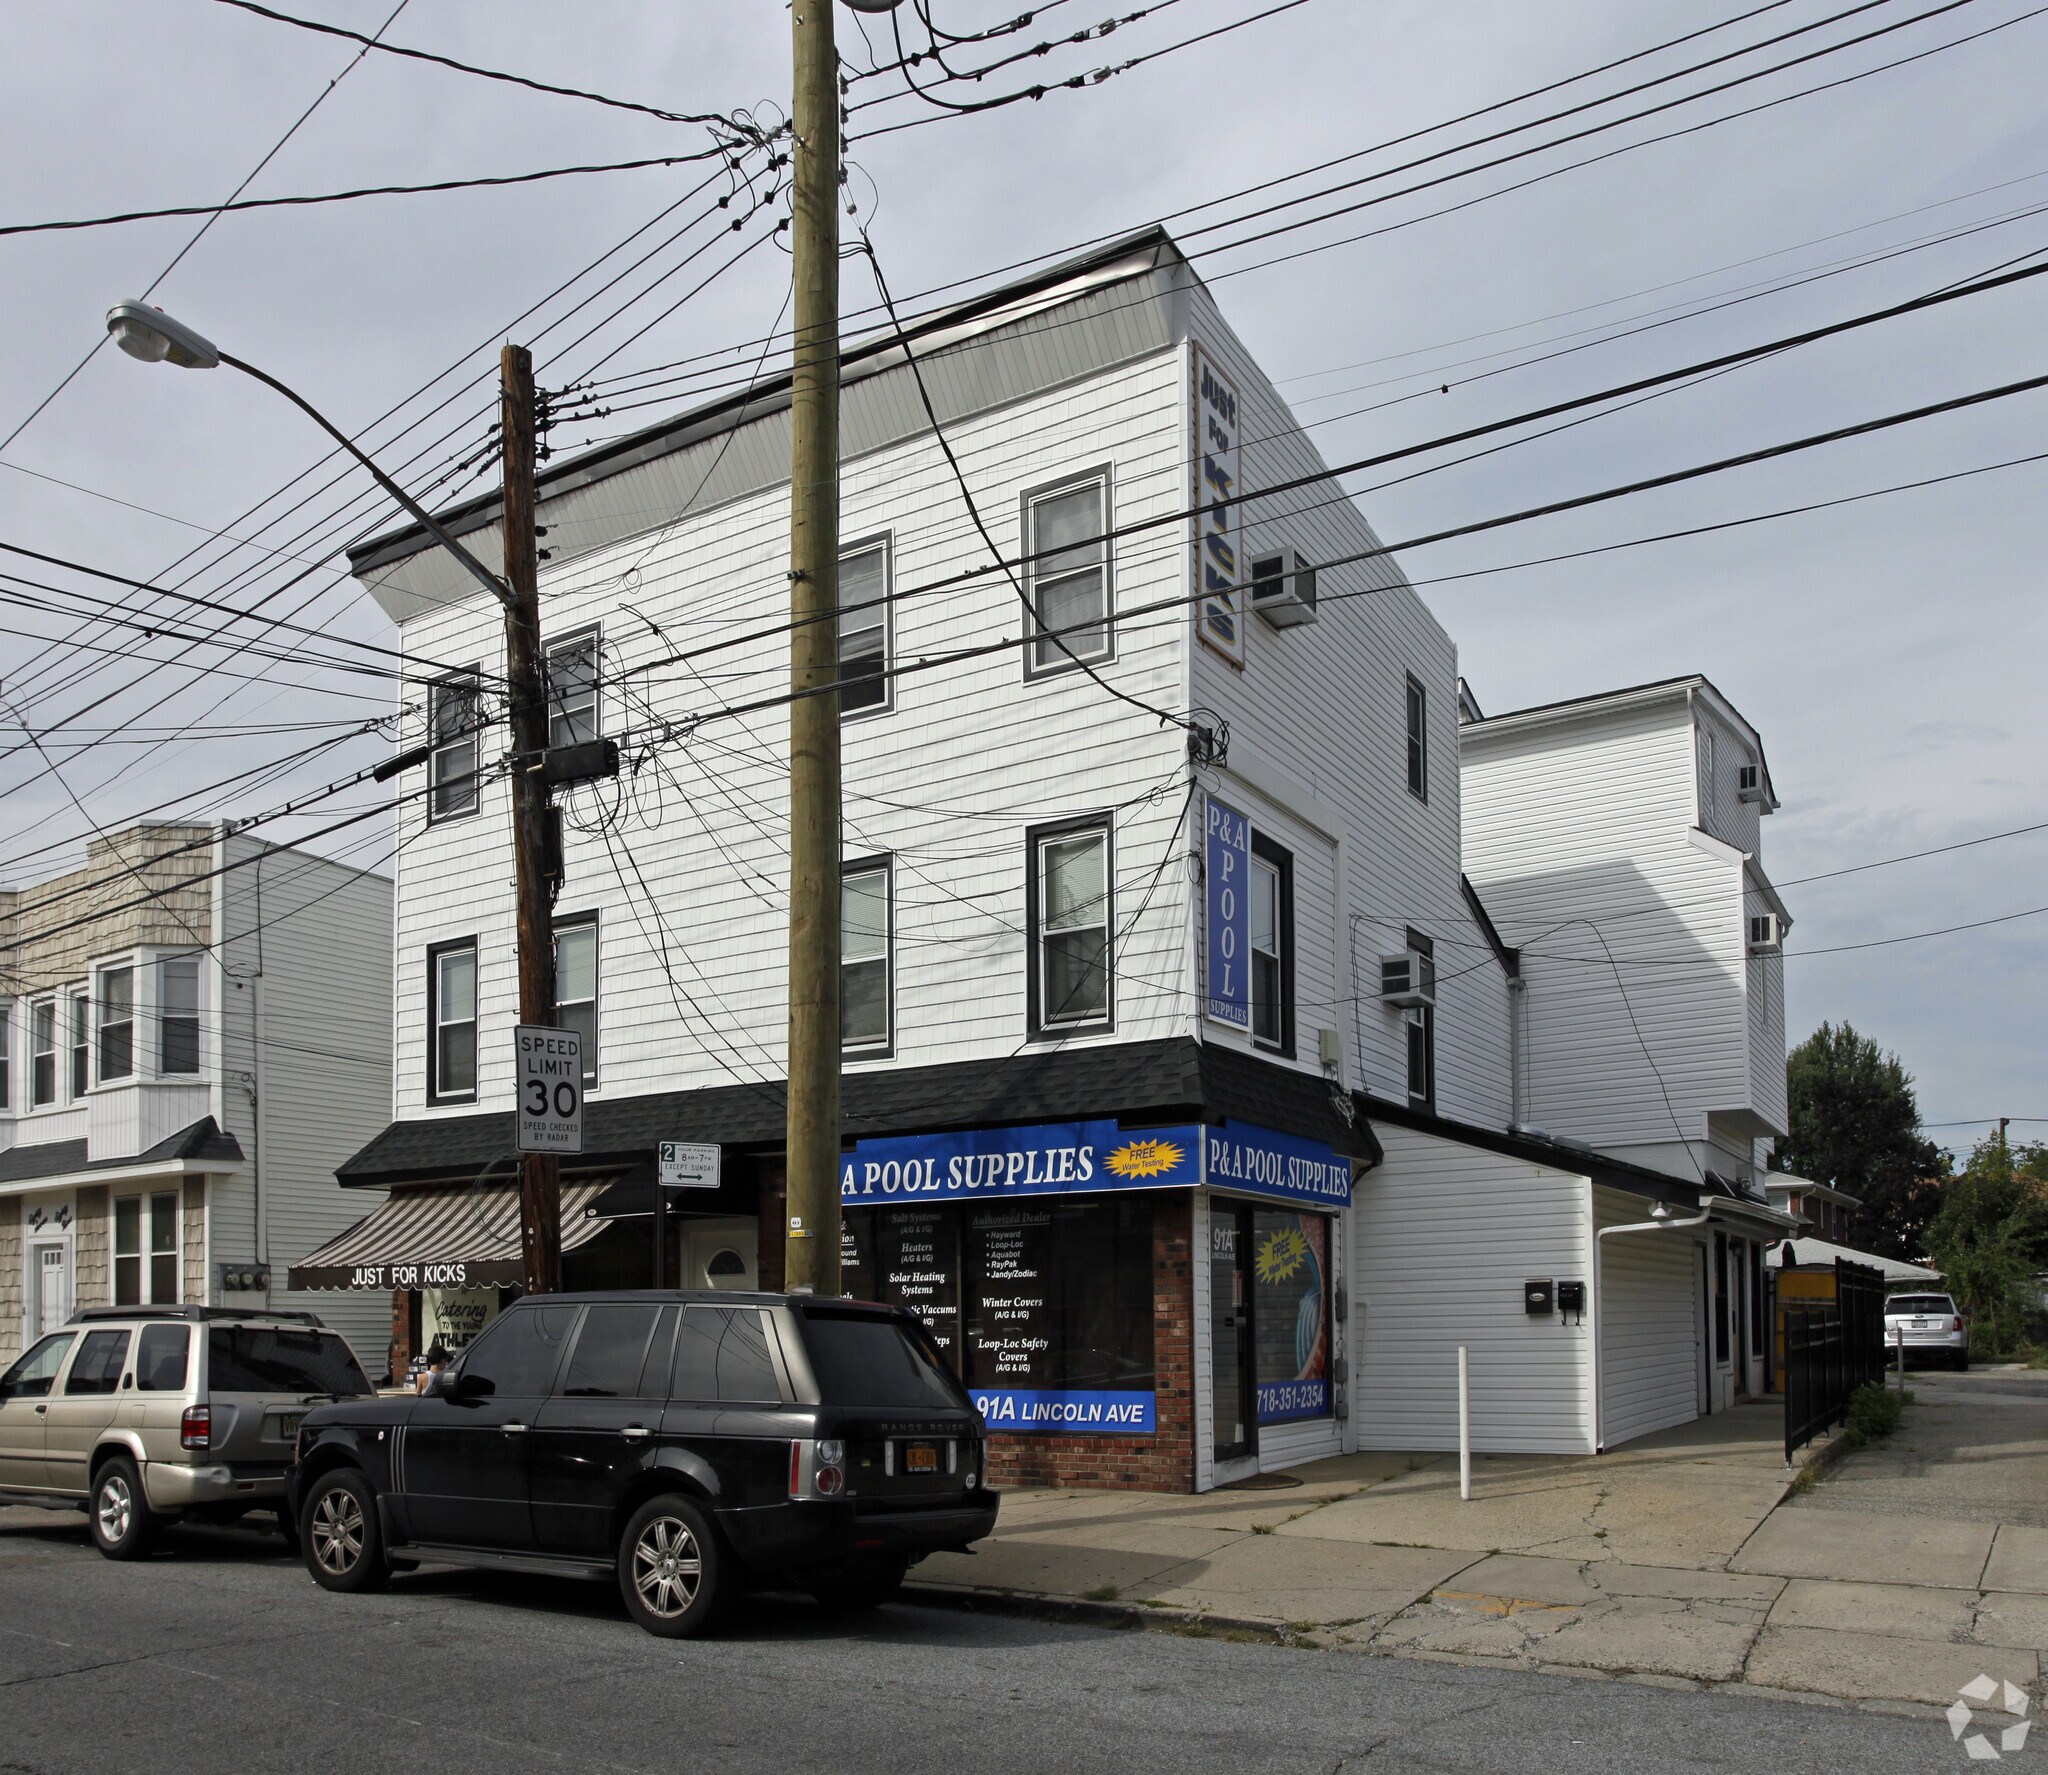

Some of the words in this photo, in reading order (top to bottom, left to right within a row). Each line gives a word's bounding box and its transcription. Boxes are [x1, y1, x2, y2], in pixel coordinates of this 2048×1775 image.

[1208, 804, 1246, 852] P&A
[1221, 849, 1236, 998] POOL
[1210, 999, 1247, 1023] SUPPLIES
[521, 1036, 578, 1056] SPEED
[528, 1058, 573, 1076] LIMIT
[525, 1079, 577, 1118] 30
[523, 1121, 546, 1131] SPEED
[549, 1123, 579, 1132] CHECKED
[534, 1133, 543, 1141] BY
[547, 1133, 569, 1142] RADAR
[664, 1144, 673, 1161] 2
[1129, 1147, 1156, 1160] FREE
[690, 1164, 715, 1172] SUNDAY
[862, 1158, 941, 1194] POOL
[947, 1145, 1094, 1190] SUPPLIES
[1122, 1163, 1140, 1171] Water
[1142, 1159, 1165, 1168] Testing
[1209, 1138, 1243, 1179] P&A
[1245, 1147, 1286, 1187] POOL
[1287, 1156, 1348, 1198] SUPPLIES
[892, 1213, 907, 1223] Salt
[908, 1212, 942, 1223] Systems
[972, 1212, 1020, 1226] Authorized
[1022, 1211, 1052, 1223] Dealer
[990, 1230, 1021, 1240] Hayward
[1213, 1227, 1233, 1252] 91A
[901, 1243, 933, 1252] Heaters
[990, 1240, 1024, 1249] Loop-Loc
[1272, 1236, 1291, 1260] FREE
[840, 1249, 858, 1257] ound
[990, 1251, 1021, 1260] Aquabot
[990, 1260, 1018, 1270] RayPak
[351, 1267, 385, 1285] JUST
[391, 1266, 418, 1284] FOR
[423, 1264, 466, 1283] KICKS
[889, 1272, 911, 1283] Solar
[912, 1271, 946, 1284] Heating
[990, 1269, 1038, 1279] Jandy/Zodiac
[901, 1285, 934, 1297] Systems
[982, 1297, 1012, 1308] Winter
[1013, 1296, 1043, 1307] Covers
[435, 1299, 488, 1322] Catering
[921, 1304, 957, 1314] Vaccums
[994, 1310, 1010, 1320] (A/G
[442, 1321, 450, 1329] TO
[451, 1321, 460, 1330] THE
[978, 1338, 1020, 1351] Loop-Loc
[1021, 1337, 1049, 1350] Safety
[998, 1351, 1028, 1361] Covers
[995, 1363, 1011, 1373] (A/G
[1011, 1363, 1017, 1371] &
[1257, 1384, 1324, 1413] 718-351-2354
[976, 1396, 1016, 1420] 91A
[1021, 1402, 1102, 1422] LINCOLN
[1105, 1404, 1144, 1423] AVE
[881, 1423, 923, 1431] RANGE
